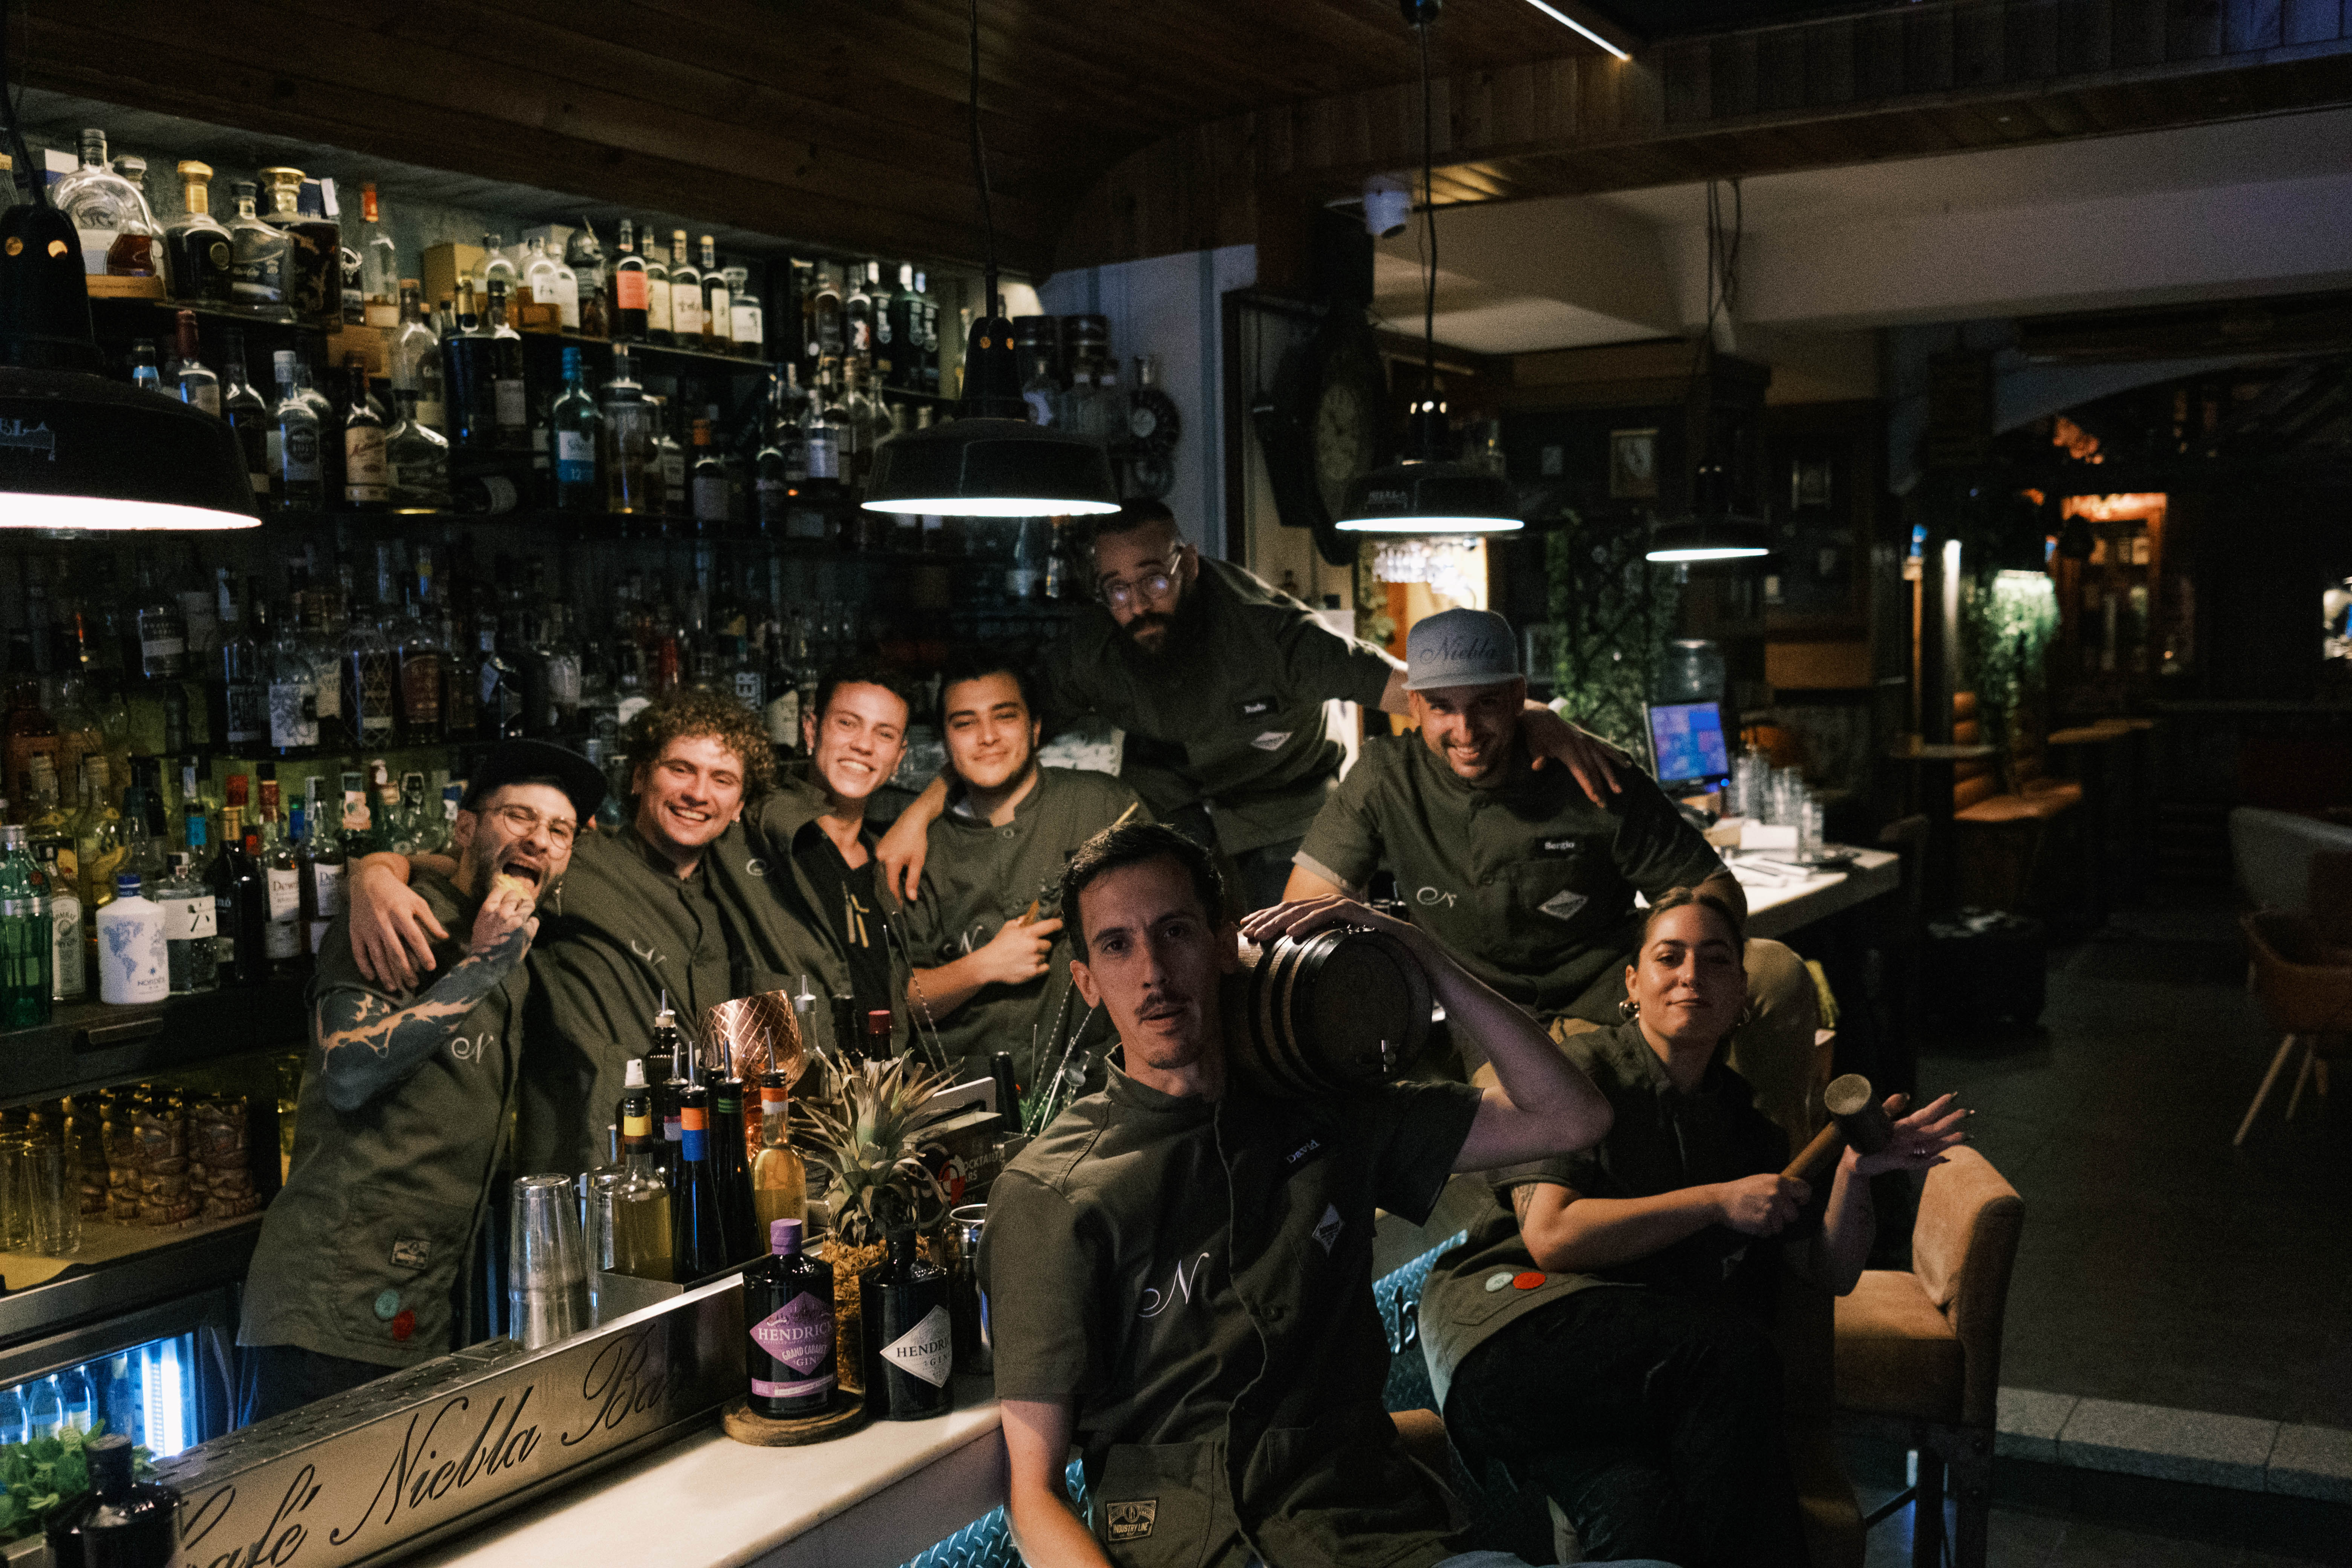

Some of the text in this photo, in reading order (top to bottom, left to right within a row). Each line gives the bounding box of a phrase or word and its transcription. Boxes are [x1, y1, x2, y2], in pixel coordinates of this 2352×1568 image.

[1544, 841, 1576, 850] Sergio
[1286, 1139, 1320, 1164] David
[1138, 1252, 1210, 1318] N
[782, 1346, 804, 1361] GRAND
[796, 1357, 816, 1366] GIN
[329, 1386, 542, 1545] Niebla
[561, 1323, 680, 1446] Bar
[1113, 1521, 1150, 1534] INDUSTRY LINE
